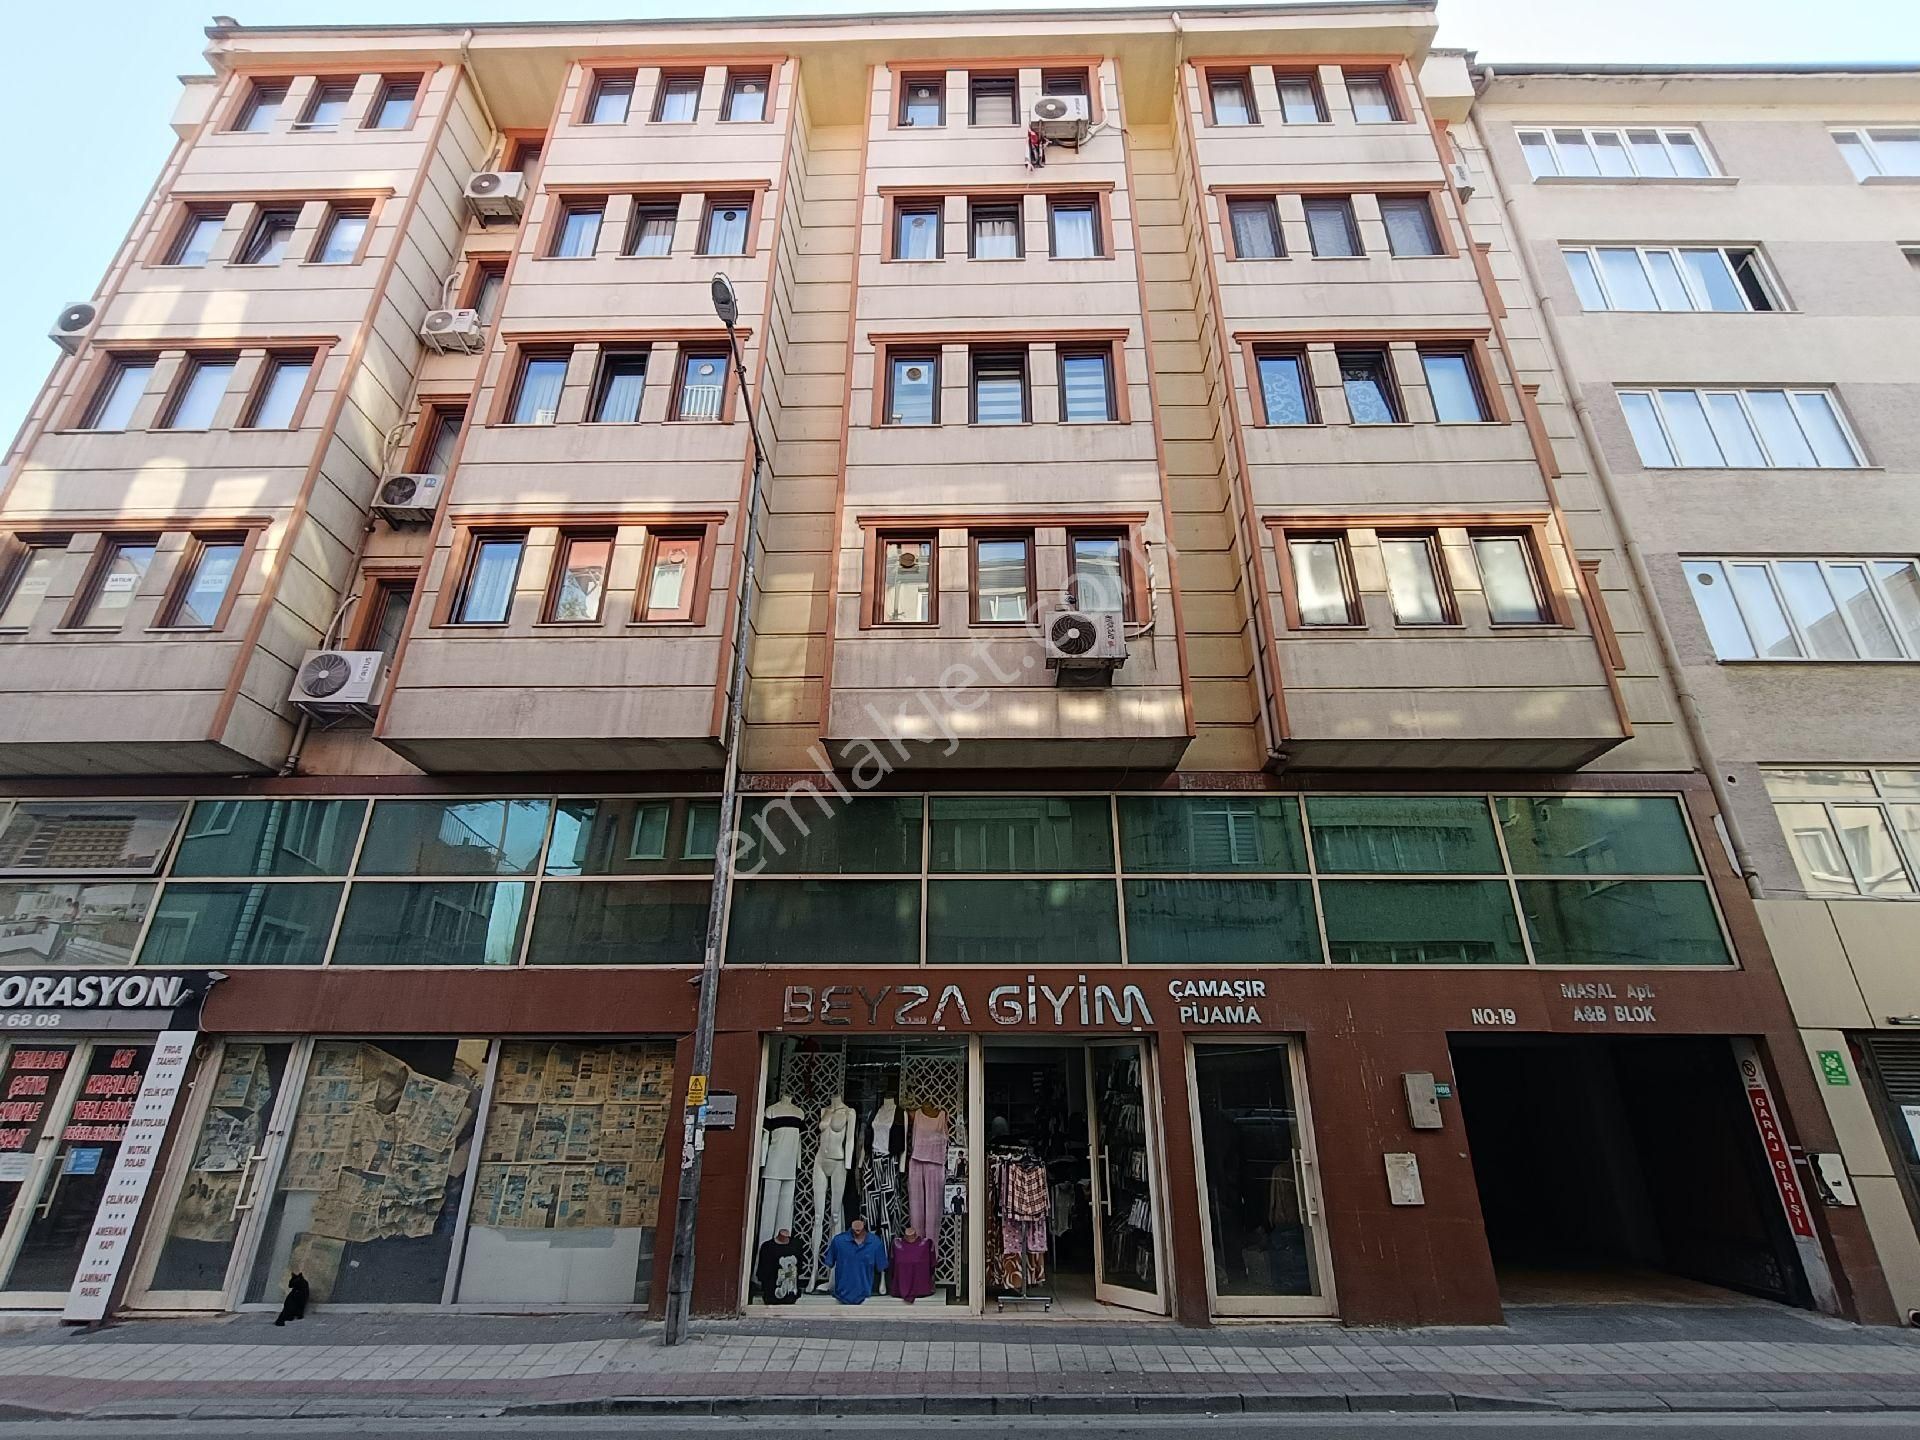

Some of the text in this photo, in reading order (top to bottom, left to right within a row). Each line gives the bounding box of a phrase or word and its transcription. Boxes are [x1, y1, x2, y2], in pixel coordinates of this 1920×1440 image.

[0, 975, 184, 1008] ORASYON
[783, 974, 1155, 1026] BEYZA GİYİM
[1168, 980, 1267, 1002] ÇAMAŞIR
[1560, 983, 1617, 999] MASAL
[7, 1013, 32, 1027] 68
[36, 1013, 61, 1027] 08
[1180, 1002, 1262, 1025] PİJAMA
[1471, 1008, 1517, 1025] NO:19
[1574, 1005, 1656, 1022] A&B BLOK
[1755, 1097, 1779, 1152] GARAJ
